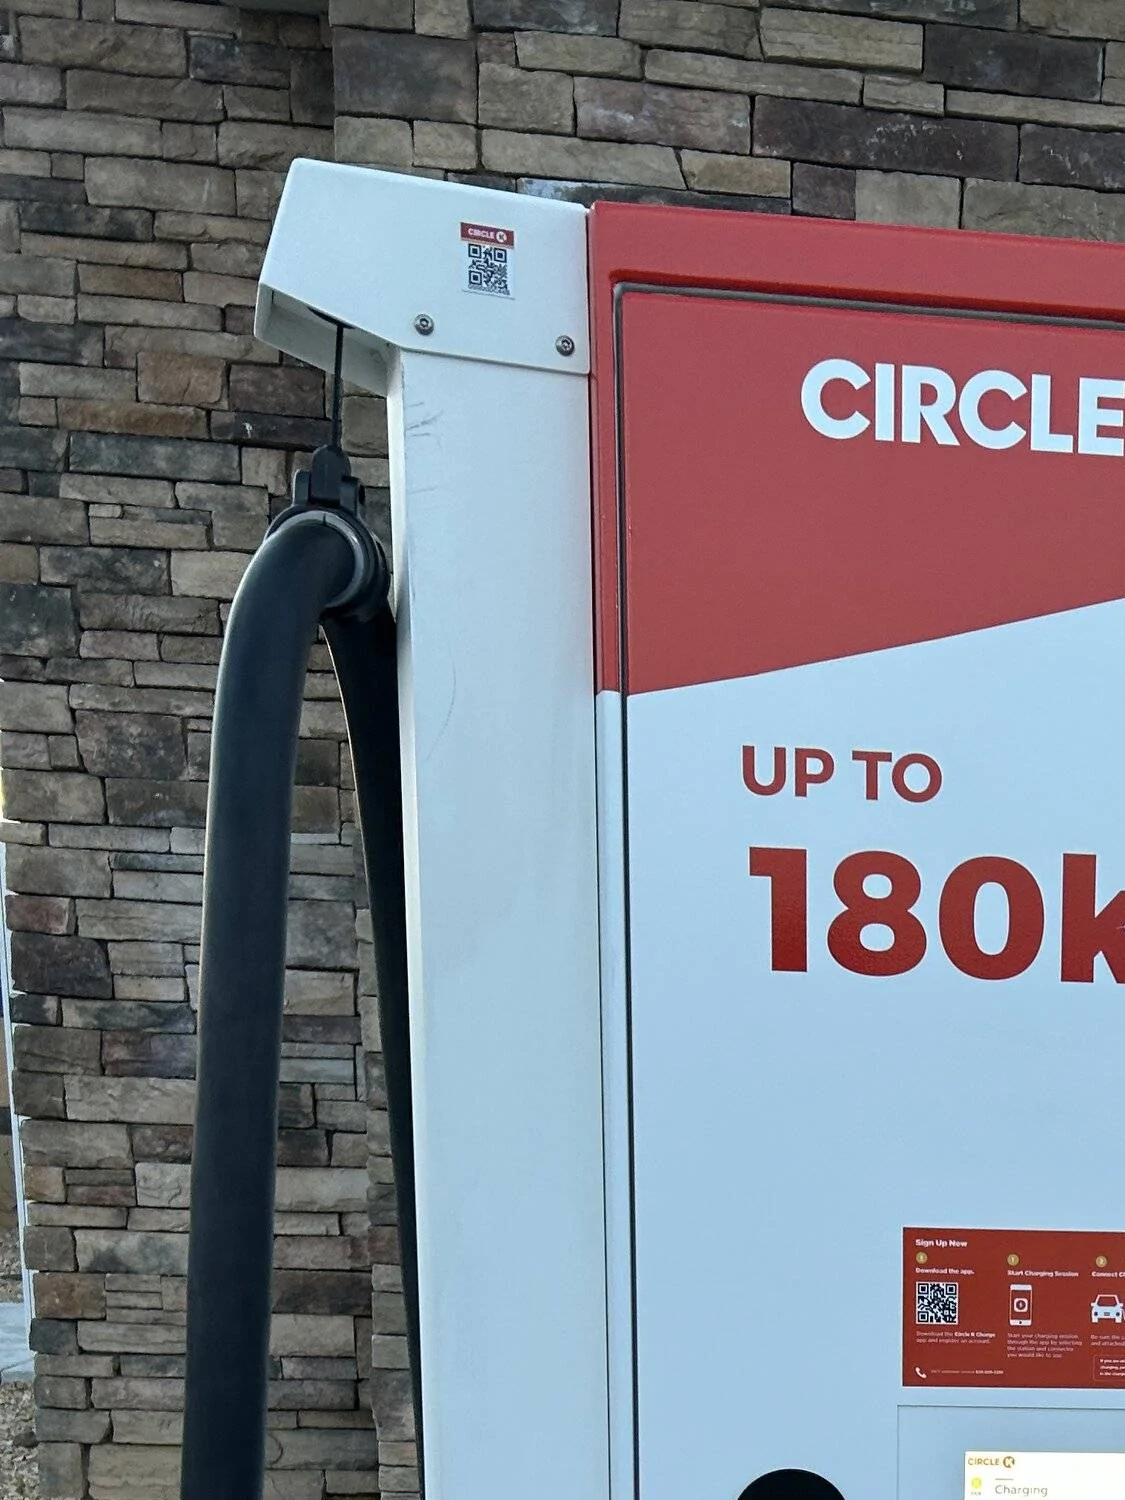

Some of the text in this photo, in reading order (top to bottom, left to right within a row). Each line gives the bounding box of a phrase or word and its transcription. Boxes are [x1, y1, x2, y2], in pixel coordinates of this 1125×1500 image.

[467, 228, 495, 239] CIRCLE
[802, 358, 1125, 457] CIRCLE
[741, 745, 943, 804] UP TO
[915, 1239, 934, 1248] Sign
[935, 1239, 948, 1248] Up
[967, 1457, 1000, 1466] CIRCLE
[994, 1484, 1048, 1497] Charging
